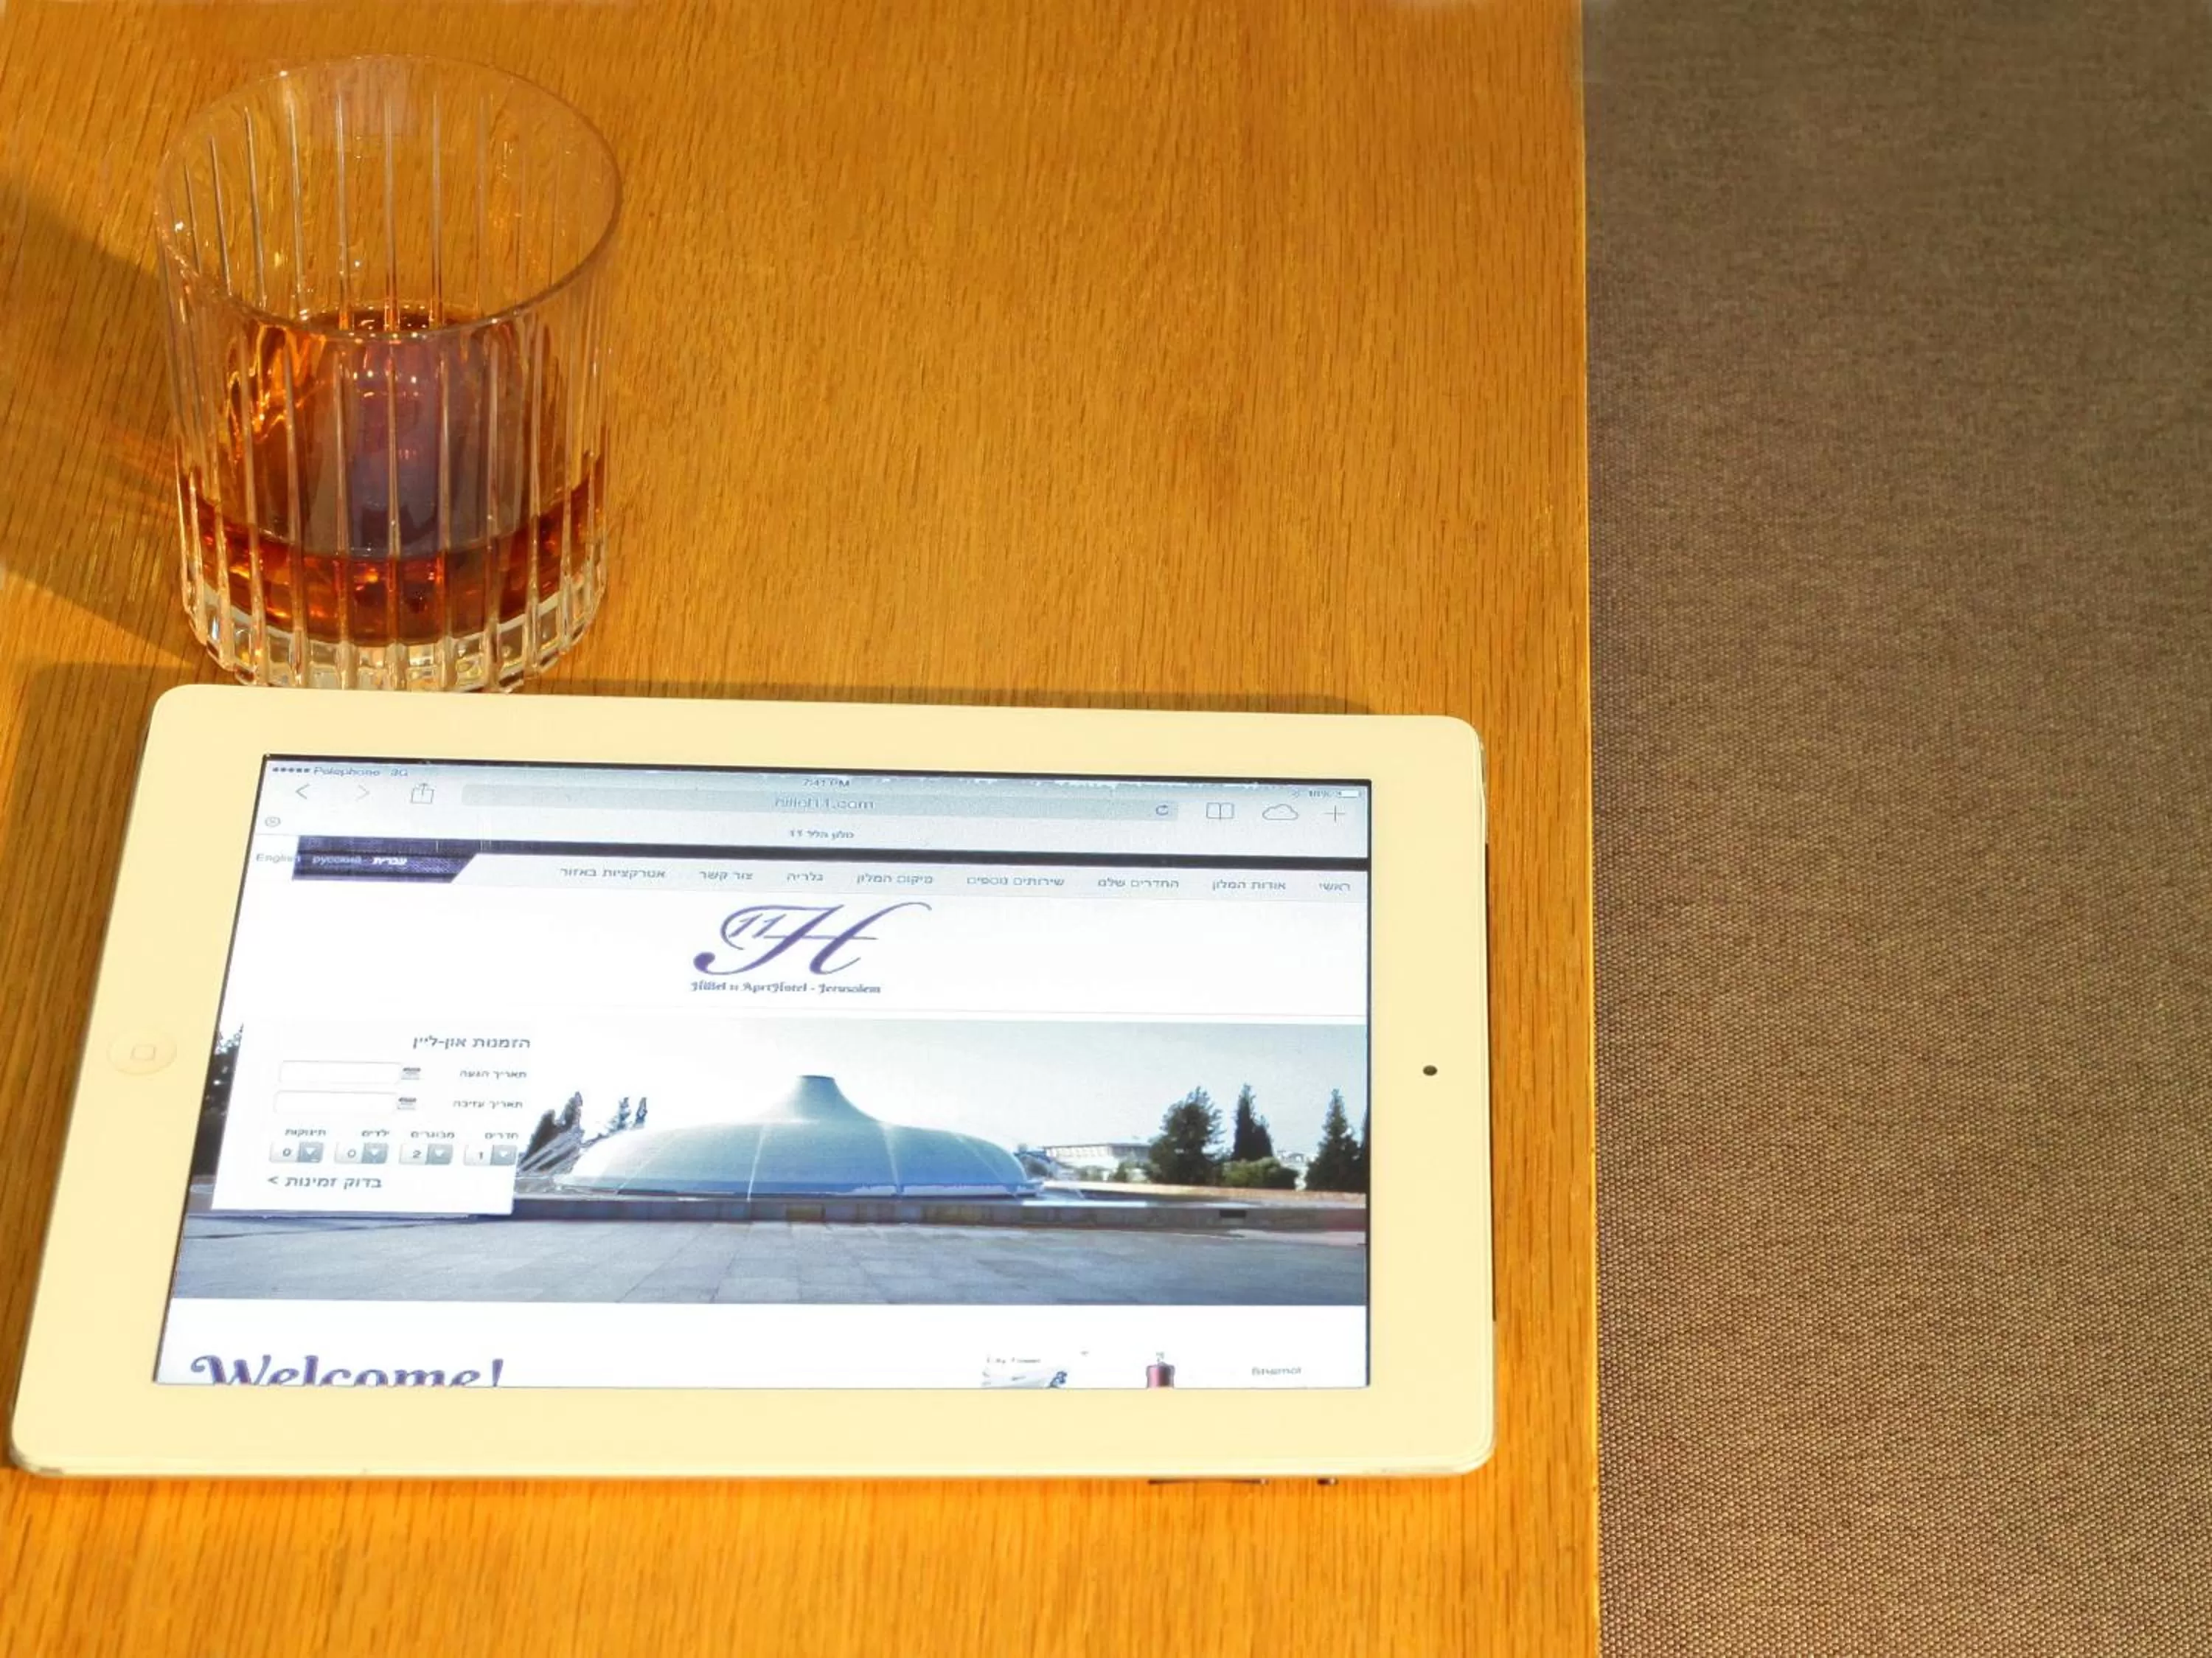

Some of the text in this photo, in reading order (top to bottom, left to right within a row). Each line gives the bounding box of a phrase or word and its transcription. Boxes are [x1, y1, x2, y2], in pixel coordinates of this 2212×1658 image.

[372, 856, 408, 866] עברית
[560, 867, 597, 877] באזור
[699, 870, 753, 882] צור קשר
[786, 873, 824, 882] גלריה
[857, 875, 933, 885] מיקום המלון
[967, 875, 1065, 886] שירותים נוספים
[1130, 878, 1179, 888] החדרים
[1212, 878, 1286, 891] אודות המלון
[1319, 881, 1351, 892] ראשי
[473, 1037, 531, 1049] הזמנות
[412, 1149, 422, 1159] 2
[285, 1176, 382, 1190] בדוק זמינות
